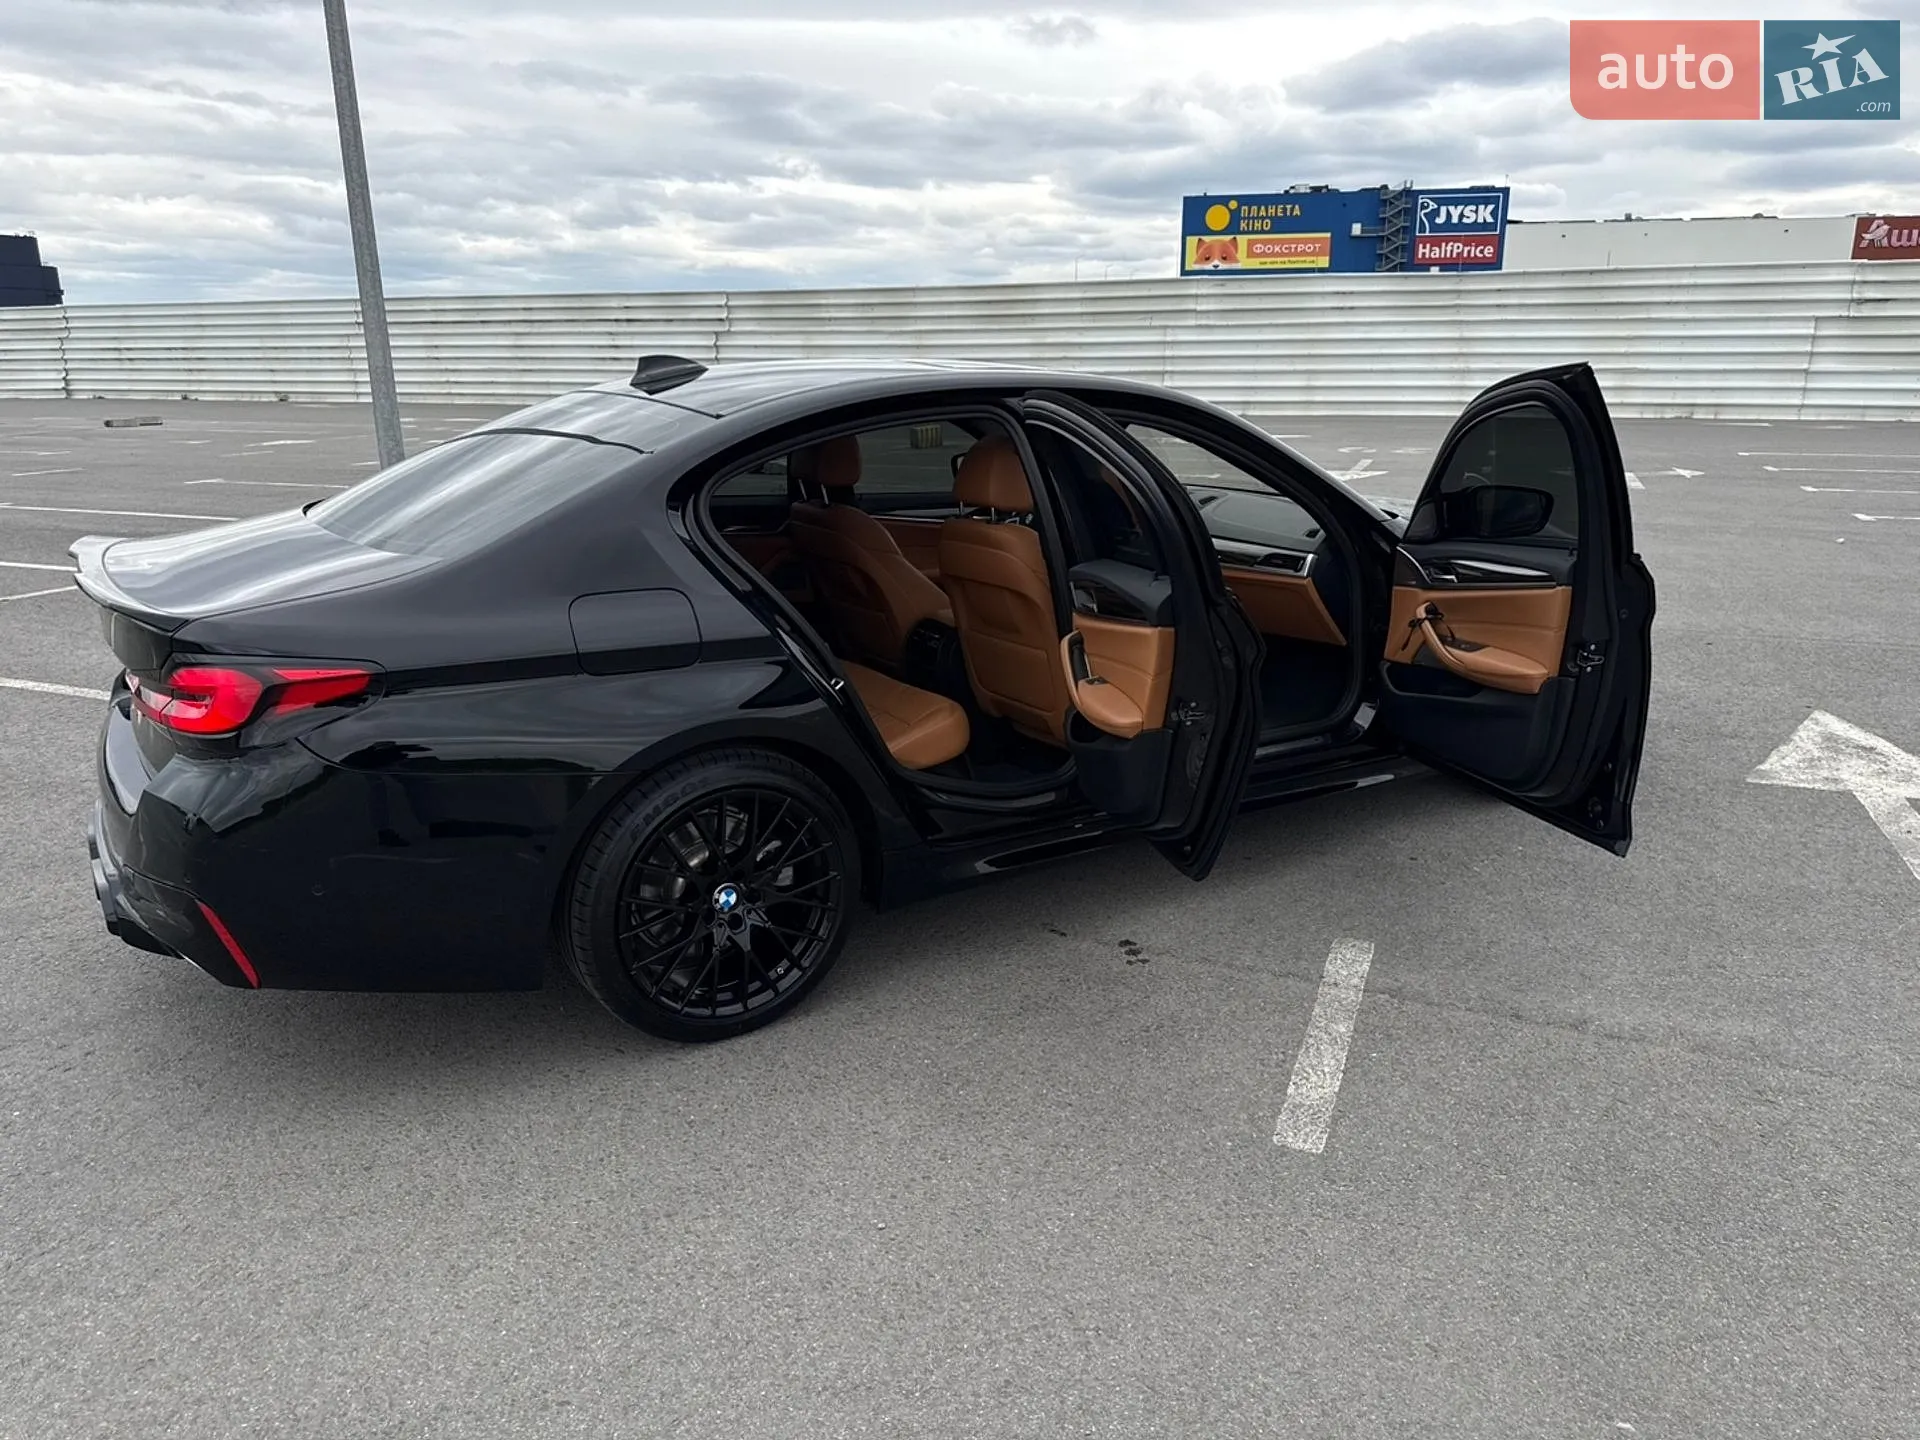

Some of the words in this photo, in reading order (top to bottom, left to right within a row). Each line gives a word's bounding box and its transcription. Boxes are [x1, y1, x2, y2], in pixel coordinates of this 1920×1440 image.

[1240, 204, 1301, 217] ПЛАНЕТА
[1434, 204, 1496, 224] JYSK
[1239, 219, 1271, 231] КІНО
[1252, 243, 1322, 253] ФОКСТРОТ
[1417, 241, 1494, 259] HalfPrice
